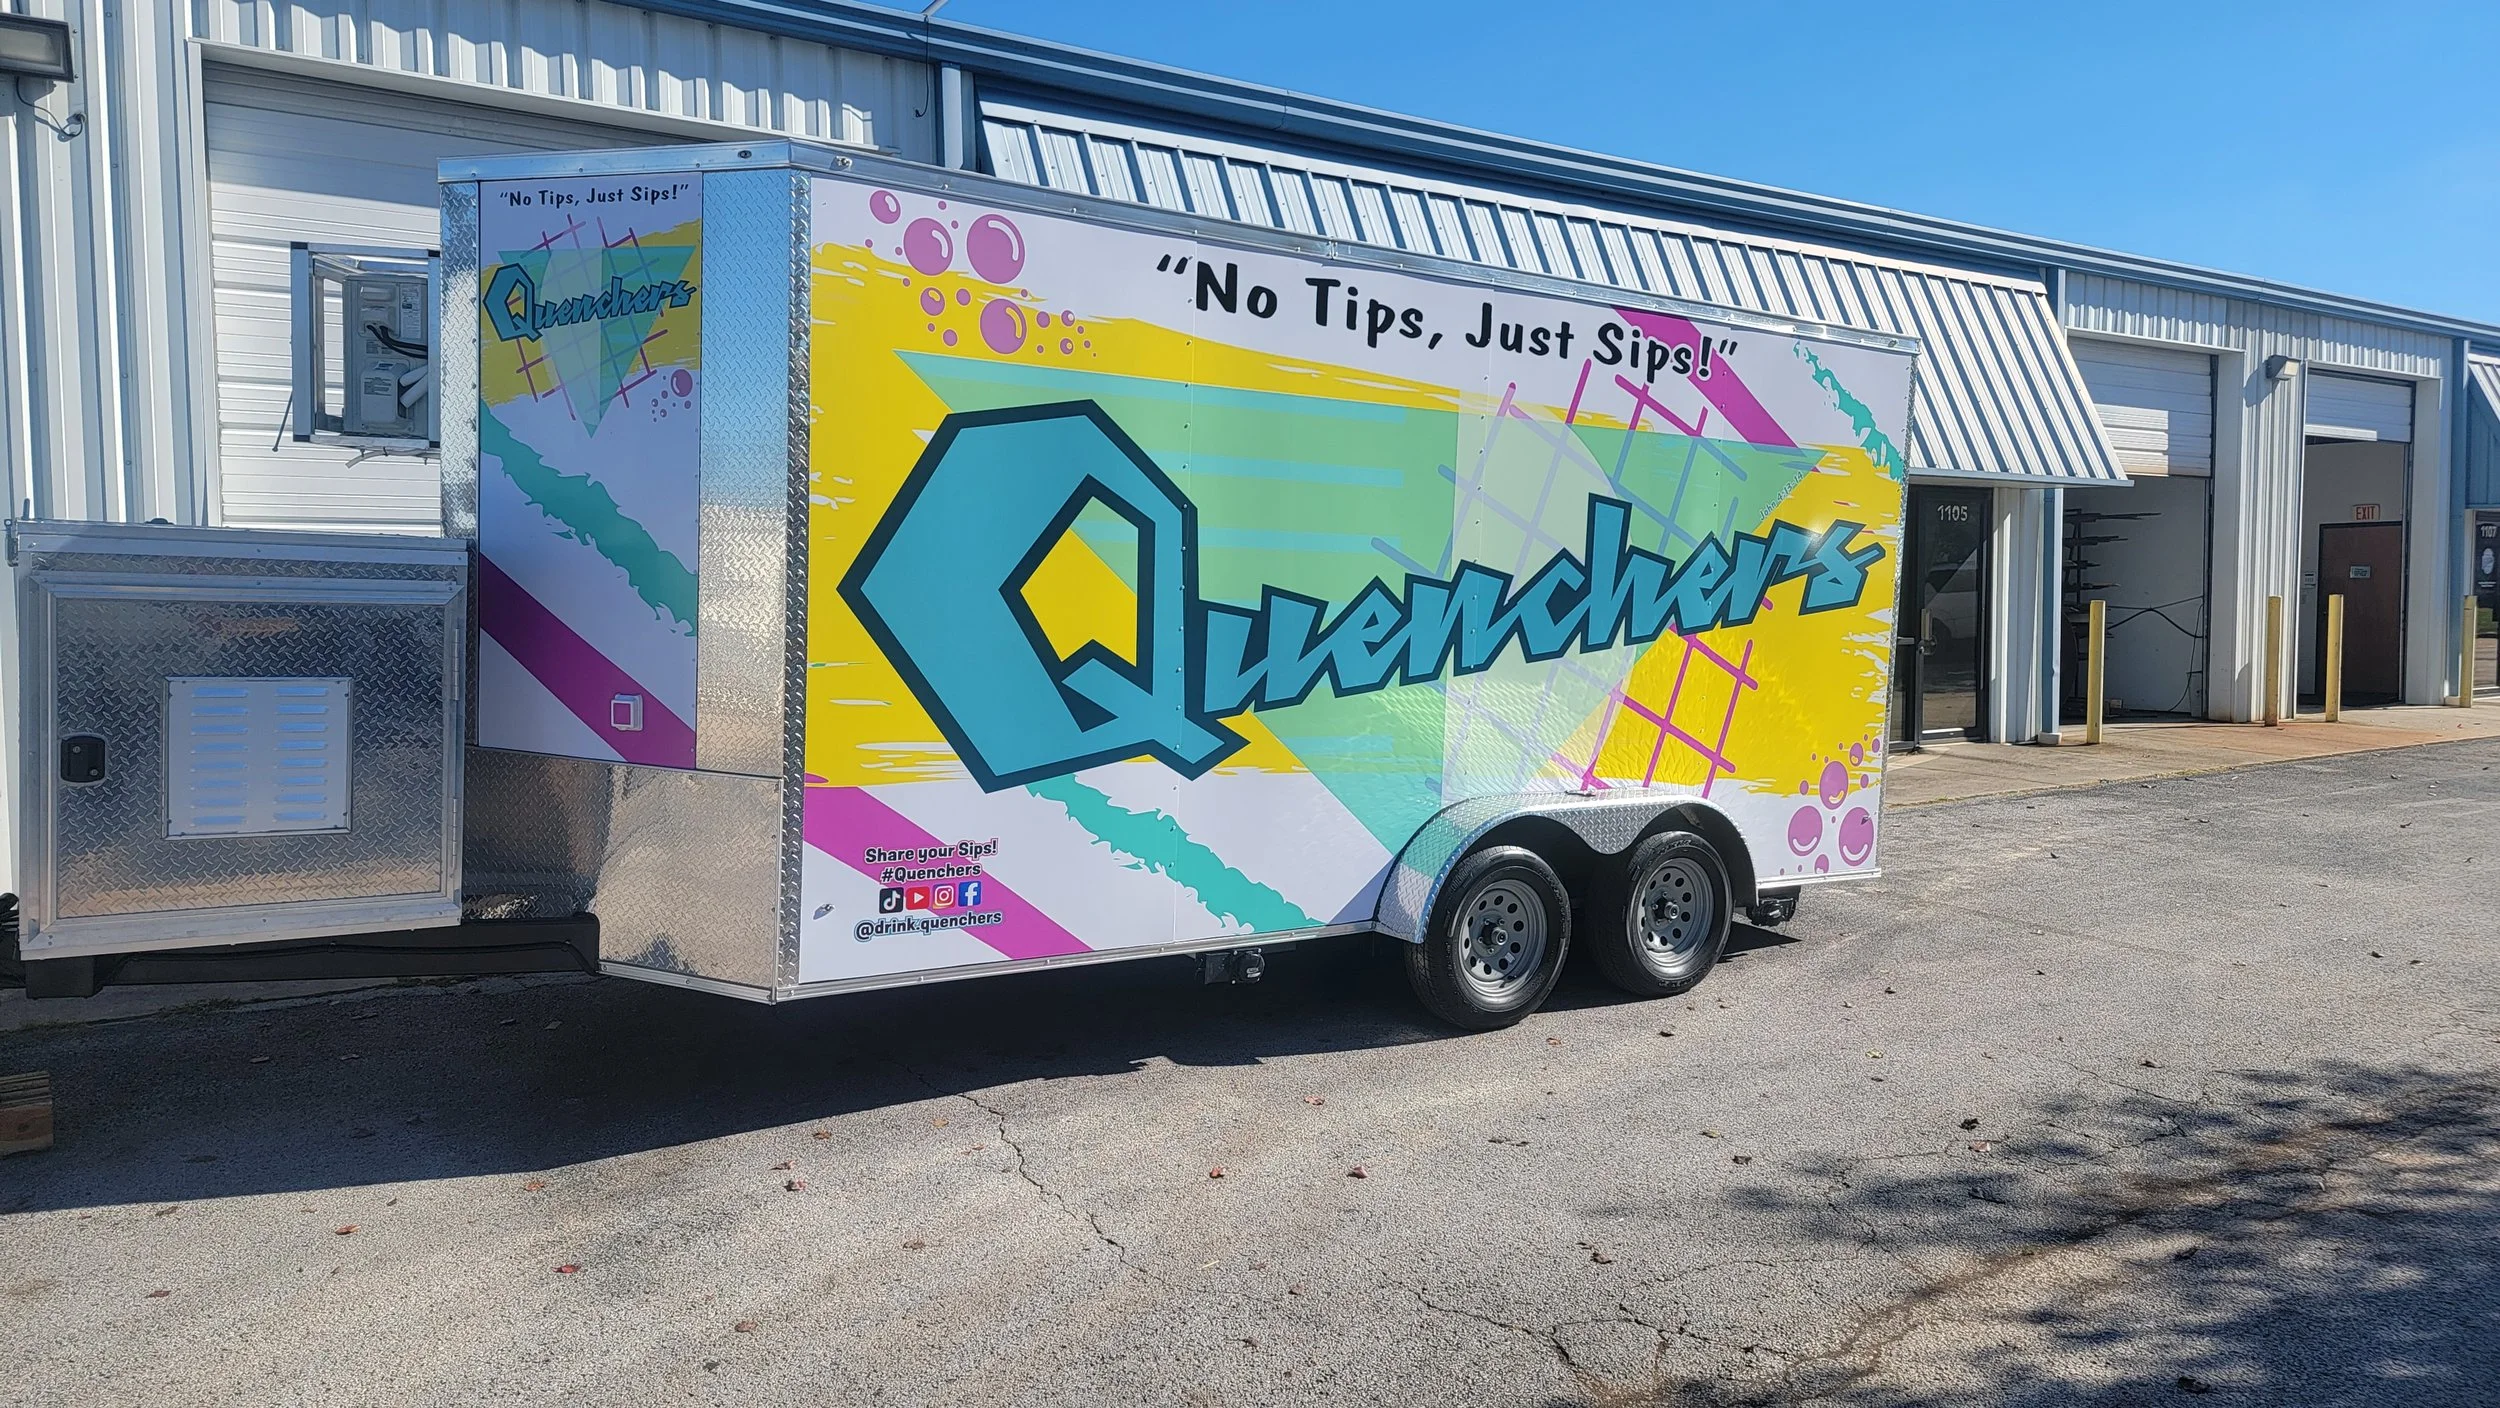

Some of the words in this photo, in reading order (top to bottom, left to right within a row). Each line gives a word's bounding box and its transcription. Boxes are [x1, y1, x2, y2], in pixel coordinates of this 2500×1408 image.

[499, 190, 532, 207] “No
[538, 189, 580, 209] Tips,
[586, 187, 624, 204] Just
[630, 184, 689, 206] Sips!”
[482, 263, 697, 343] Quenchers
[1156, 253, 1278, 319] “No
[1305, 276, 1443, 351] Tips,
[1465, 301, 1575, 360] Just
[1592, 321, 1738, 384] Sips!”
[1759, 501, 1777, 521] John
[1937, 504, 1968, 522] 1105
[2355, 505, 2376, 521] EXIT
[2480, 525, 2497, 538] 1107
[836, 399, 1887, 794] Quenchers
[864, 846, 915, 864] Share
[918, 845, 956, 864] your
[957, 838, 999, 860] Sips!
[880, 863, 982, 883] #Quenchers
[855, 910, 1003, 942] @drink.quenchers
